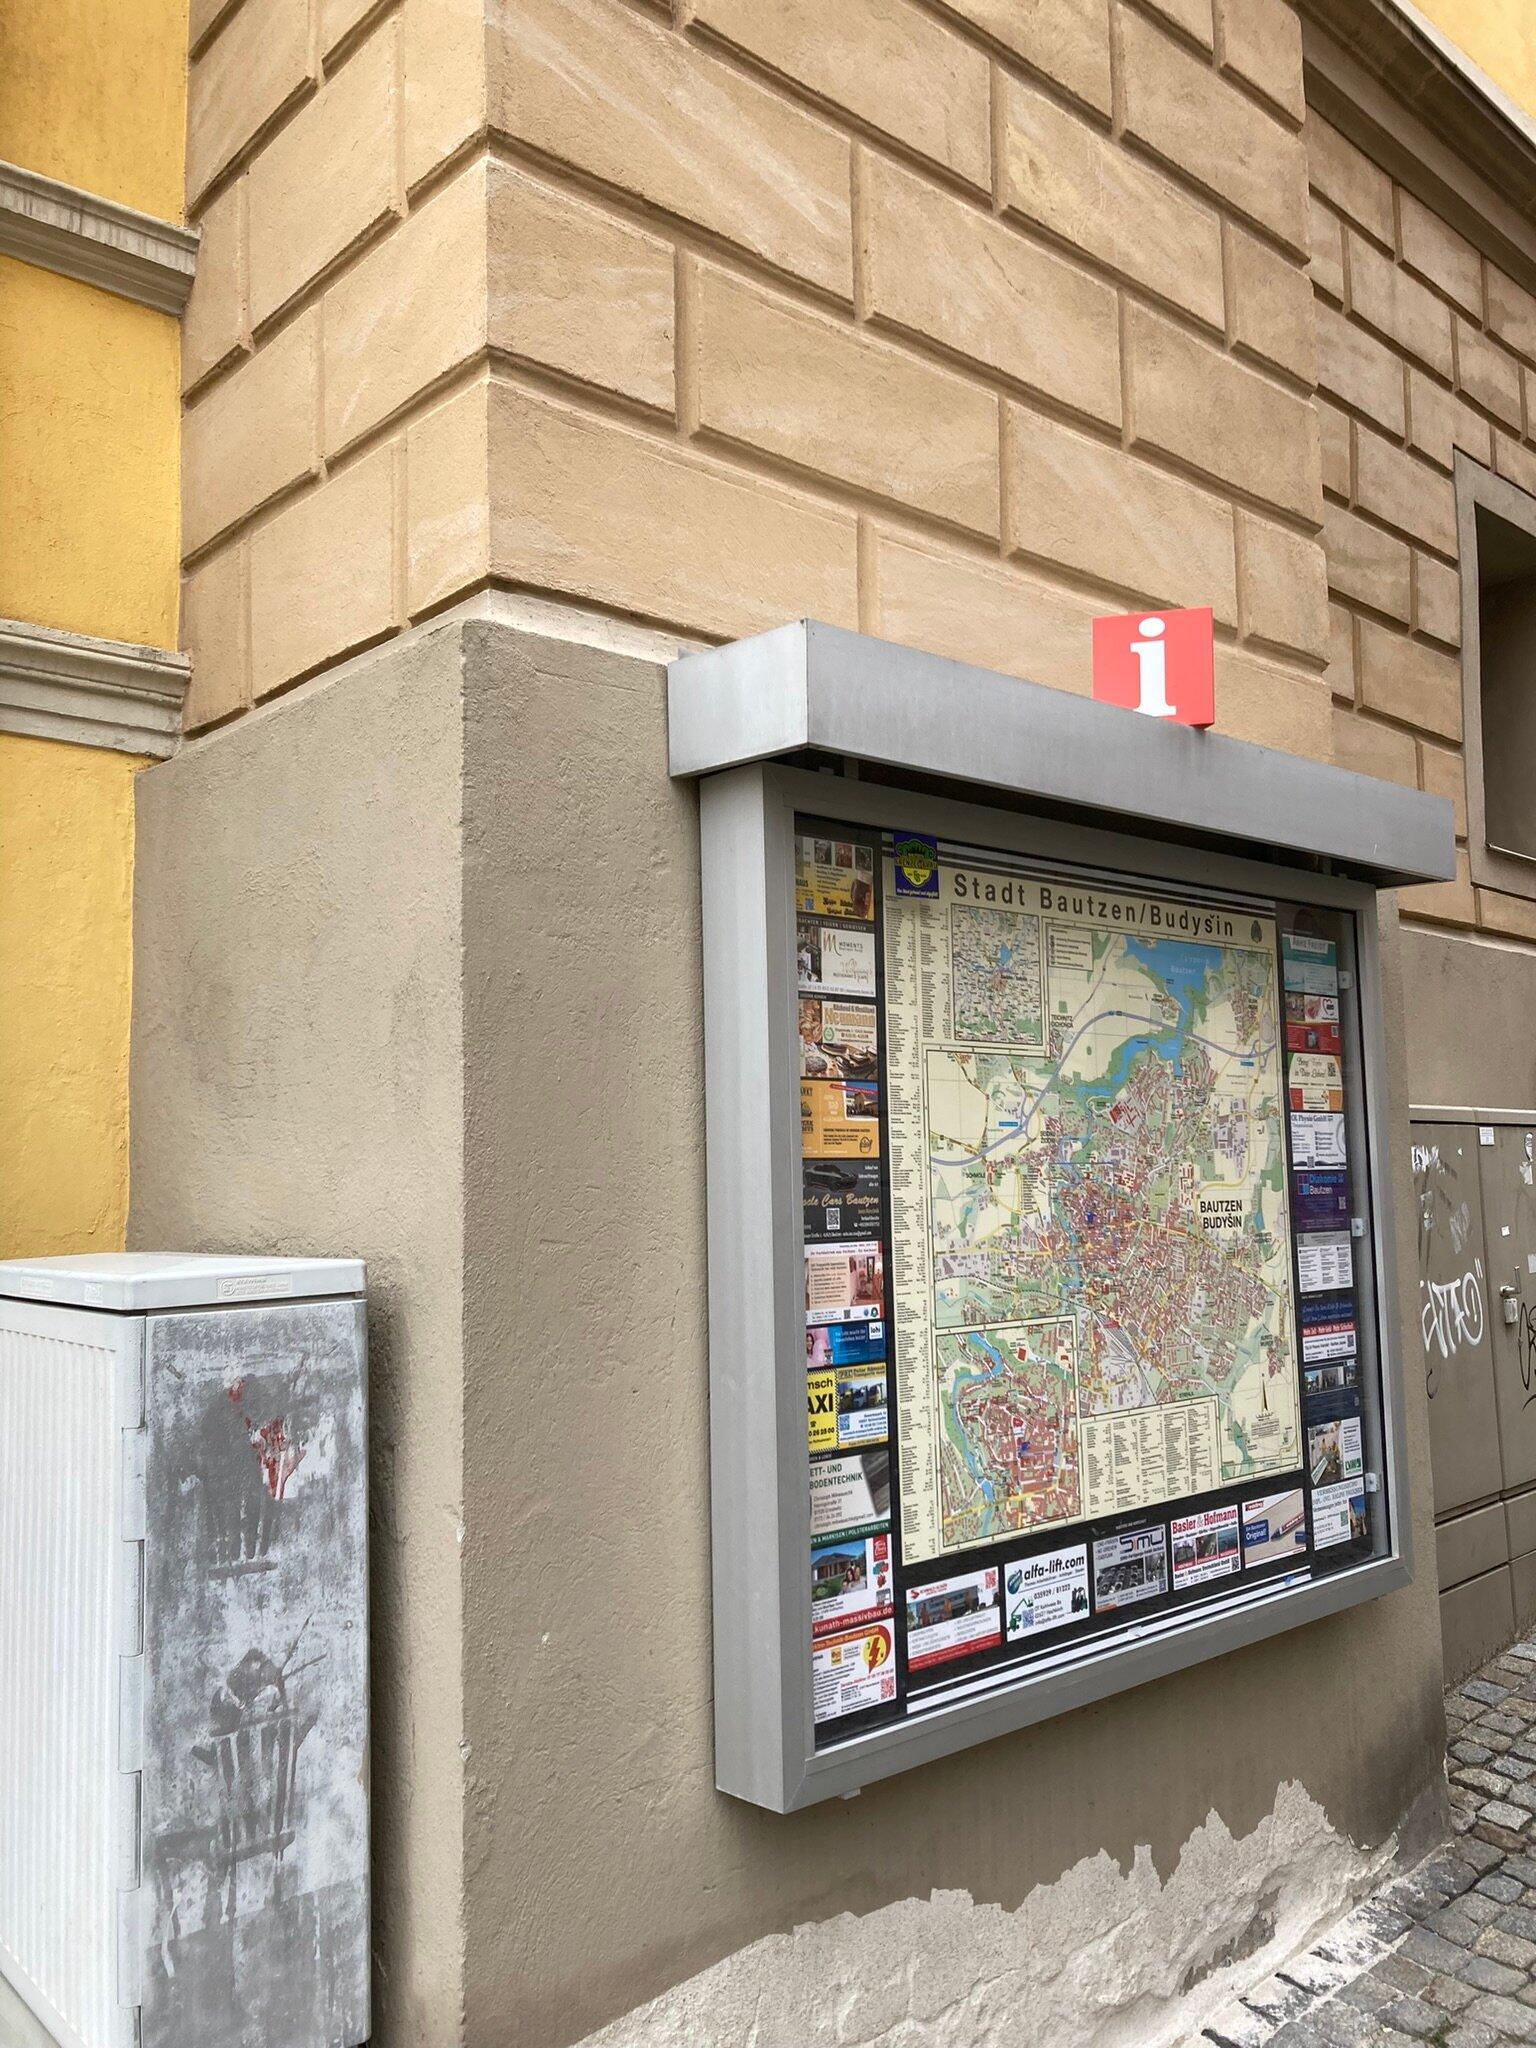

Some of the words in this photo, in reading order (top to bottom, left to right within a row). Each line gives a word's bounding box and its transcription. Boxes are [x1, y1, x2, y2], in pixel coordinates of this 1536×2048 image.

[1130, 617, 1176, 717] i
[954, 873, 1026, 906] Stadt
[1040, 886, 1233, 937] Bautzen/Budyšin
[838, 941, 863, 949] MOMENTS
[824, 1008, 875, 1026] Neumann
[1298, 1115, 1313, 1123] Physio
[1310, 1174, 1337, 1183] Diakonie
[1310, 1185, 1333, 1195] Bautzen
[821, 1193, 843, 1207] Cars
[846, 1193, 879, 1207] Bautzen
[1200, 1200, 1242, 1213] BAUTZEN
[1203, 1213, 1242, 1229] BUDYŠIN
[827, 1463, 843, 1474] UND
[809, 1472, 863, 1489] BODENTECHNIK
[1247, 1501, 1263, 1510] edding
[1172, 1519, 1196, 1534] Basler
[1197, 1515, 1203, 1528] &
[1204, 1509, 1237, 1526] Hofmann
[1246, 1528, 1267, 1541] Original!
[1024, 1556, 1084, 1580] alfa-lift.com
[1034, 1589, 1052, 1600] 035939
[1056, 1584, 1071, 1593] 81222
[814, 1606, 892, 1633] kunath-massivbau.de
